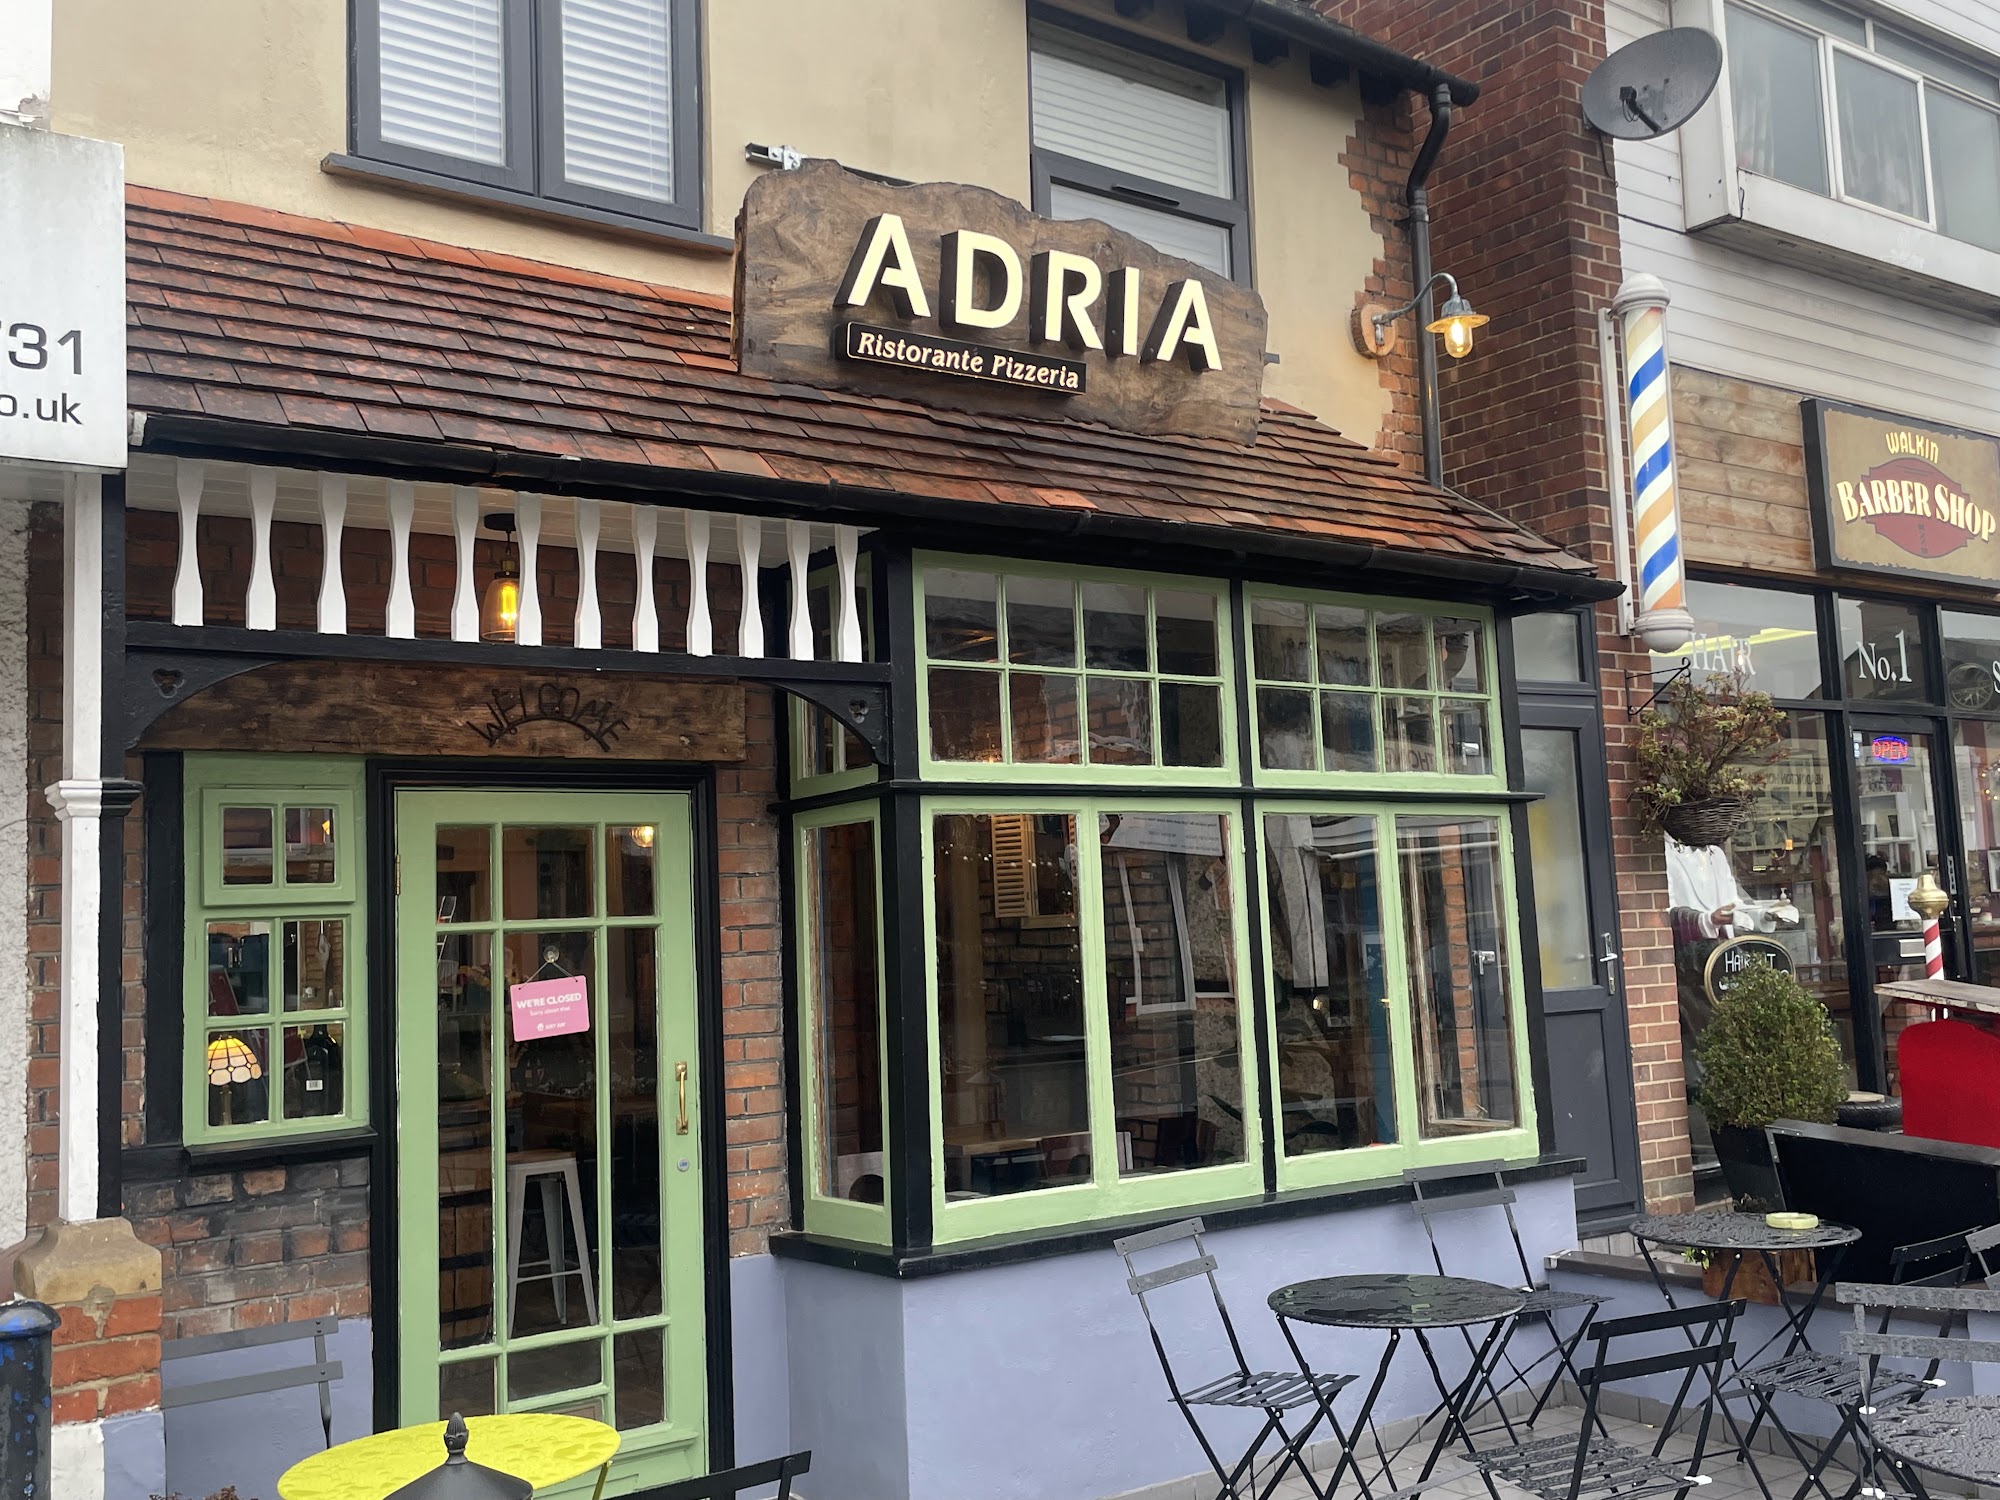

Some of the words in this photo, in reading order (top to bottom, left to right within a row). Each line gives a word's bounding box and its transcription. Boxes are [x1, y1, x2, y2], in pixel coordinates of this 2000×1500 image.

[846, 213, 1223, 371] ADRIA
[0, 322, 82, 375] 31
[857, 331, 984, 373] Ristorante
[990, 354, 1079, 389] Pizzeria
[1836, 479, 1931, 522] BARBER
[1934, 483, 1996, 542] SHOP
[1690, 631, 1757, 676] HAIR
[1856, 629, 1912, 682] No.1
[466, 683, 631, 751] WELCOME
[1871, 741, 1908, 760] OPEN
[1725, 951, 1777, 974] HAIRT
[516, 997, 546, 1009] WE'RE
[546, 992, 582, 1005] CLOSED
